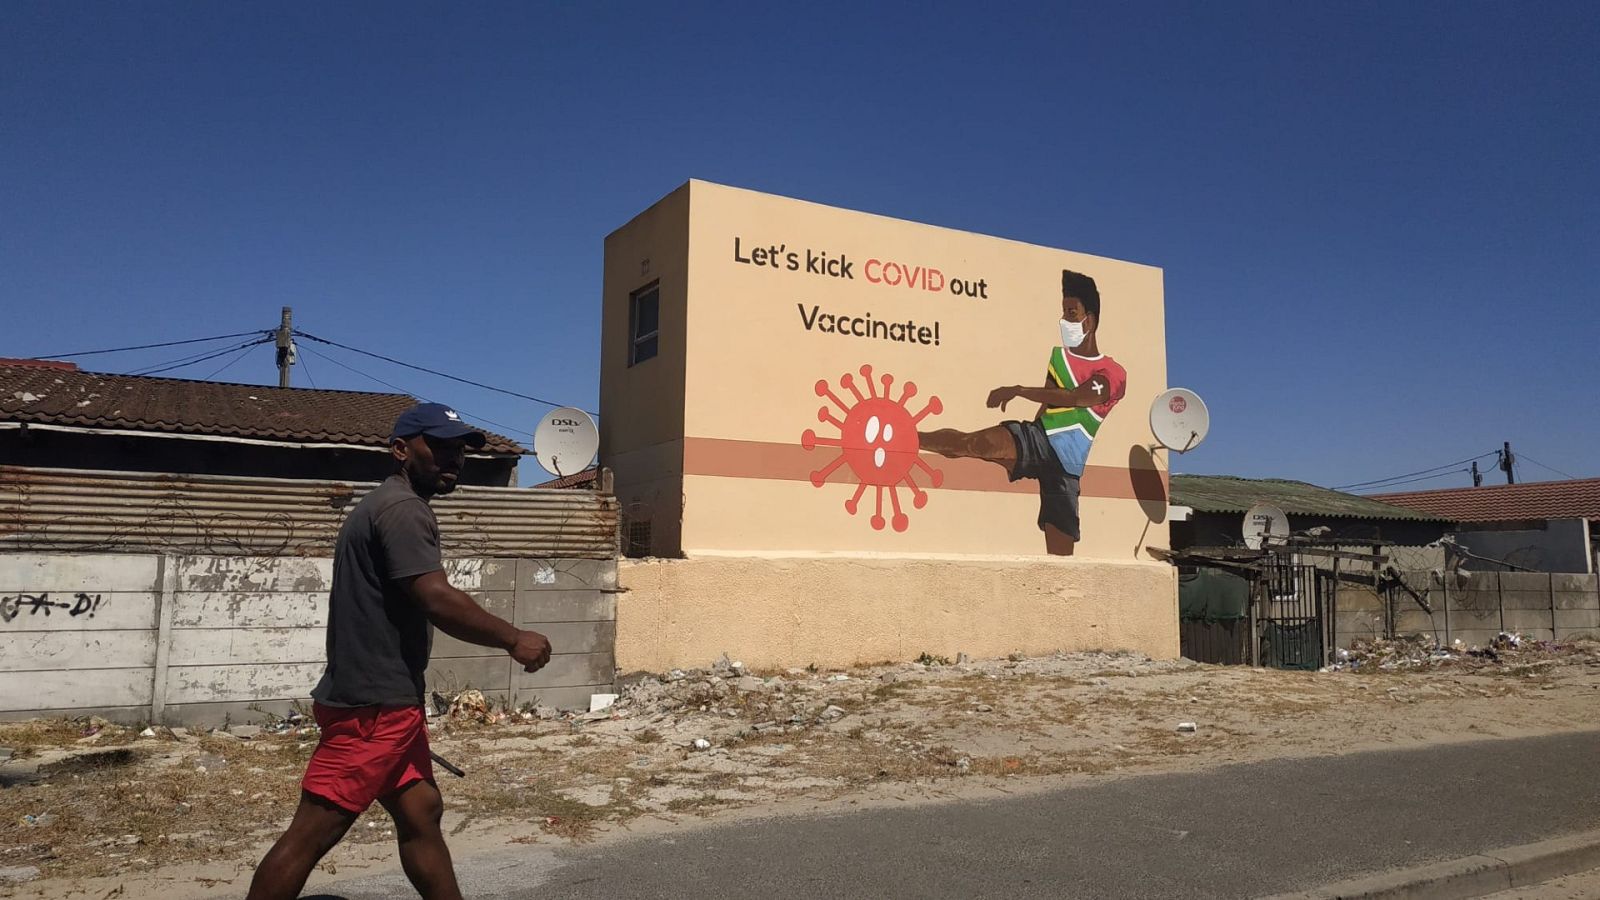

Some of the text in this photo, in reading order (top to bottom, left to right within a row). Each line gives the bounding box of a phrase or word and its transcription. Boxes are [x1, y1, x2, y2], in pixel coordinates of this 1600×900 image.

[734, 236, 988, 300] Let's kick COVID out
[797, 302, 940, 346] Vaccinate!
